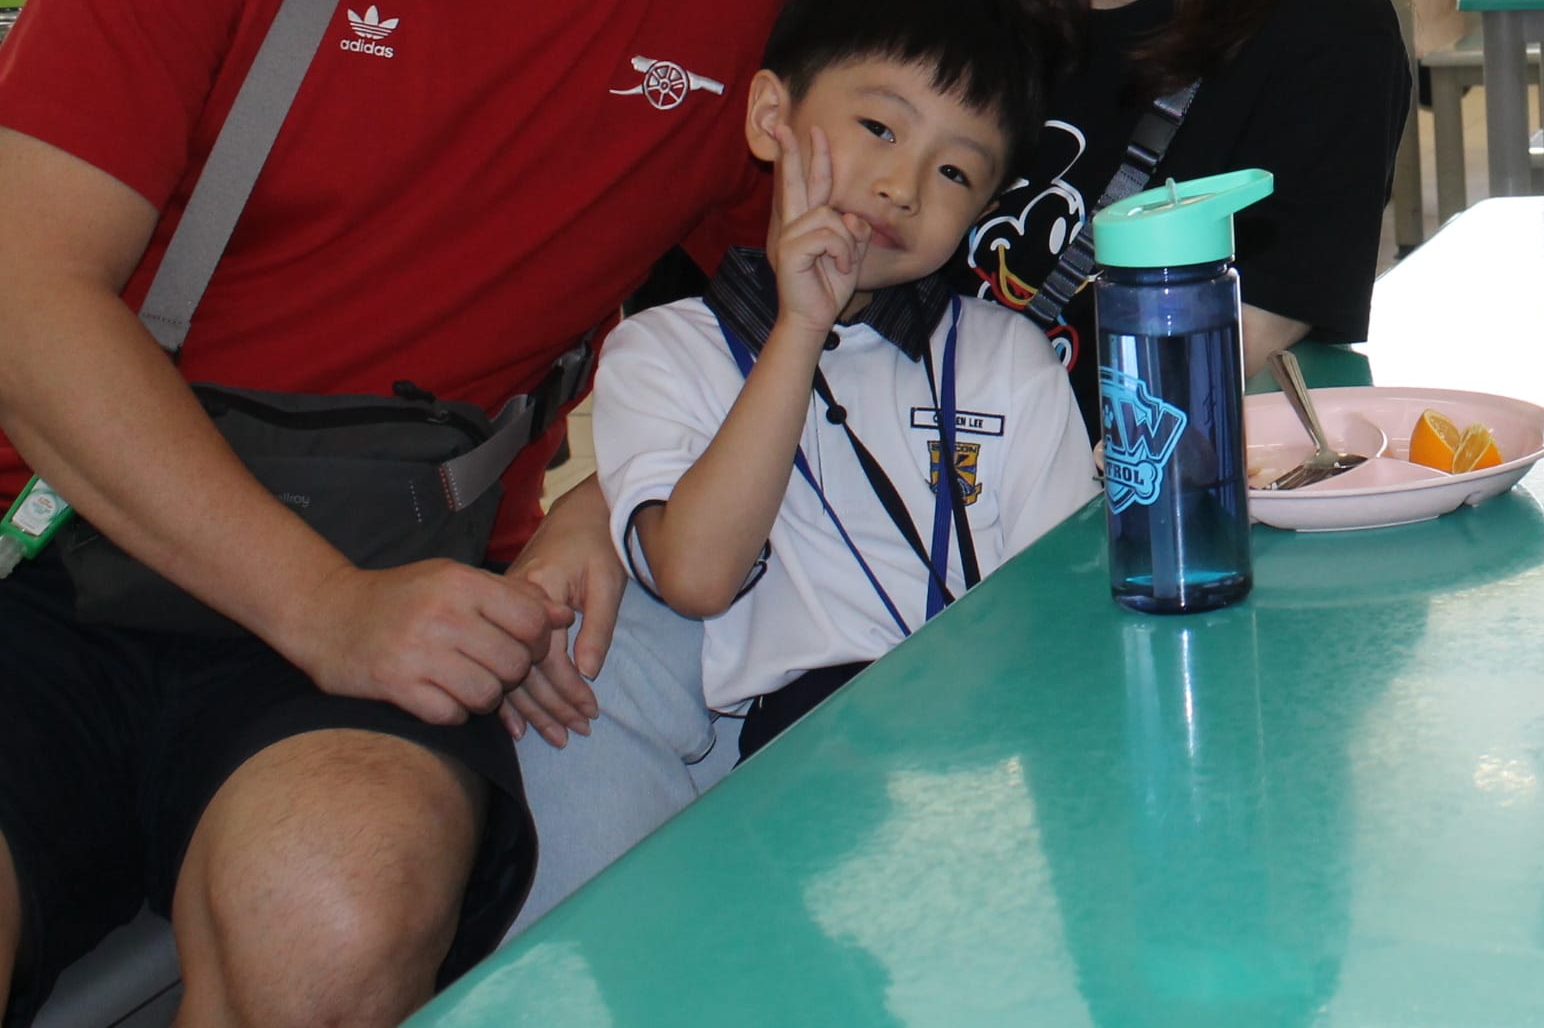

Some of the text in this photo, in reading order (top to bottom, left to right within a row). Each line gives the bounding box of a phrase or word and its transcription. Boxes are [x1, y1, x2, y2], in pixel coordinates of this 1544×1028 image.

[340, 39, 393, 58] adidas
[968, 418, 983, 428] LEE
[1101, 395, 1181, 460] AW
[1105, 461, 1145, 486] TROL
